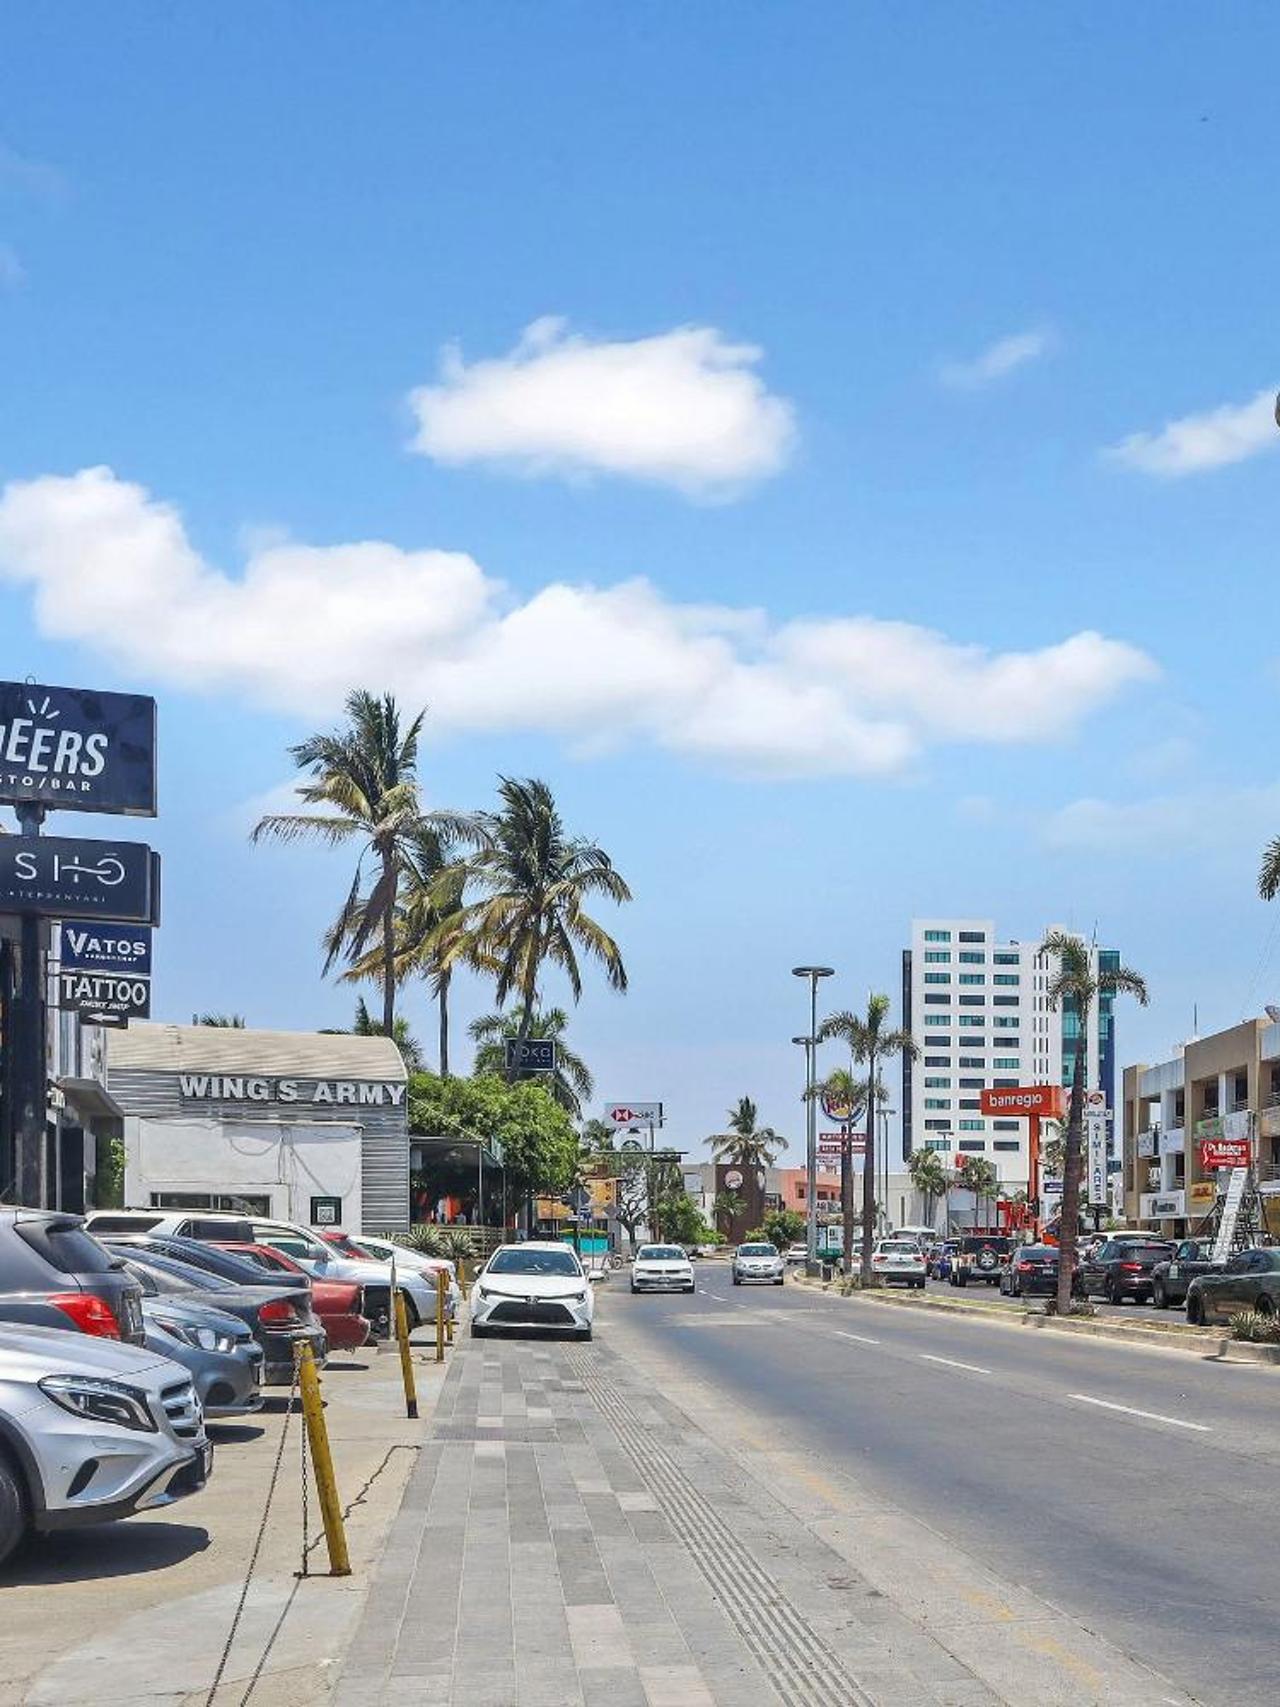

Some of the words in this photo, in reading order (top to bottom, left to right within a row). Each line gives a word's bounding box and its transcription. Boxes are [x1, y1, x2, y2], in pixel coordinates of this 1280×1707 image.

[0, 718, 108, 776] EERS
[66, 928, 146, 956] VATOS
[61, 975, 147, 1006] TATTOO
[179, 1076, 299, 1101] WING'S
[312, 1081, 407, 1105] ARMY
[988, 1092, 1043, 1108] banregio
